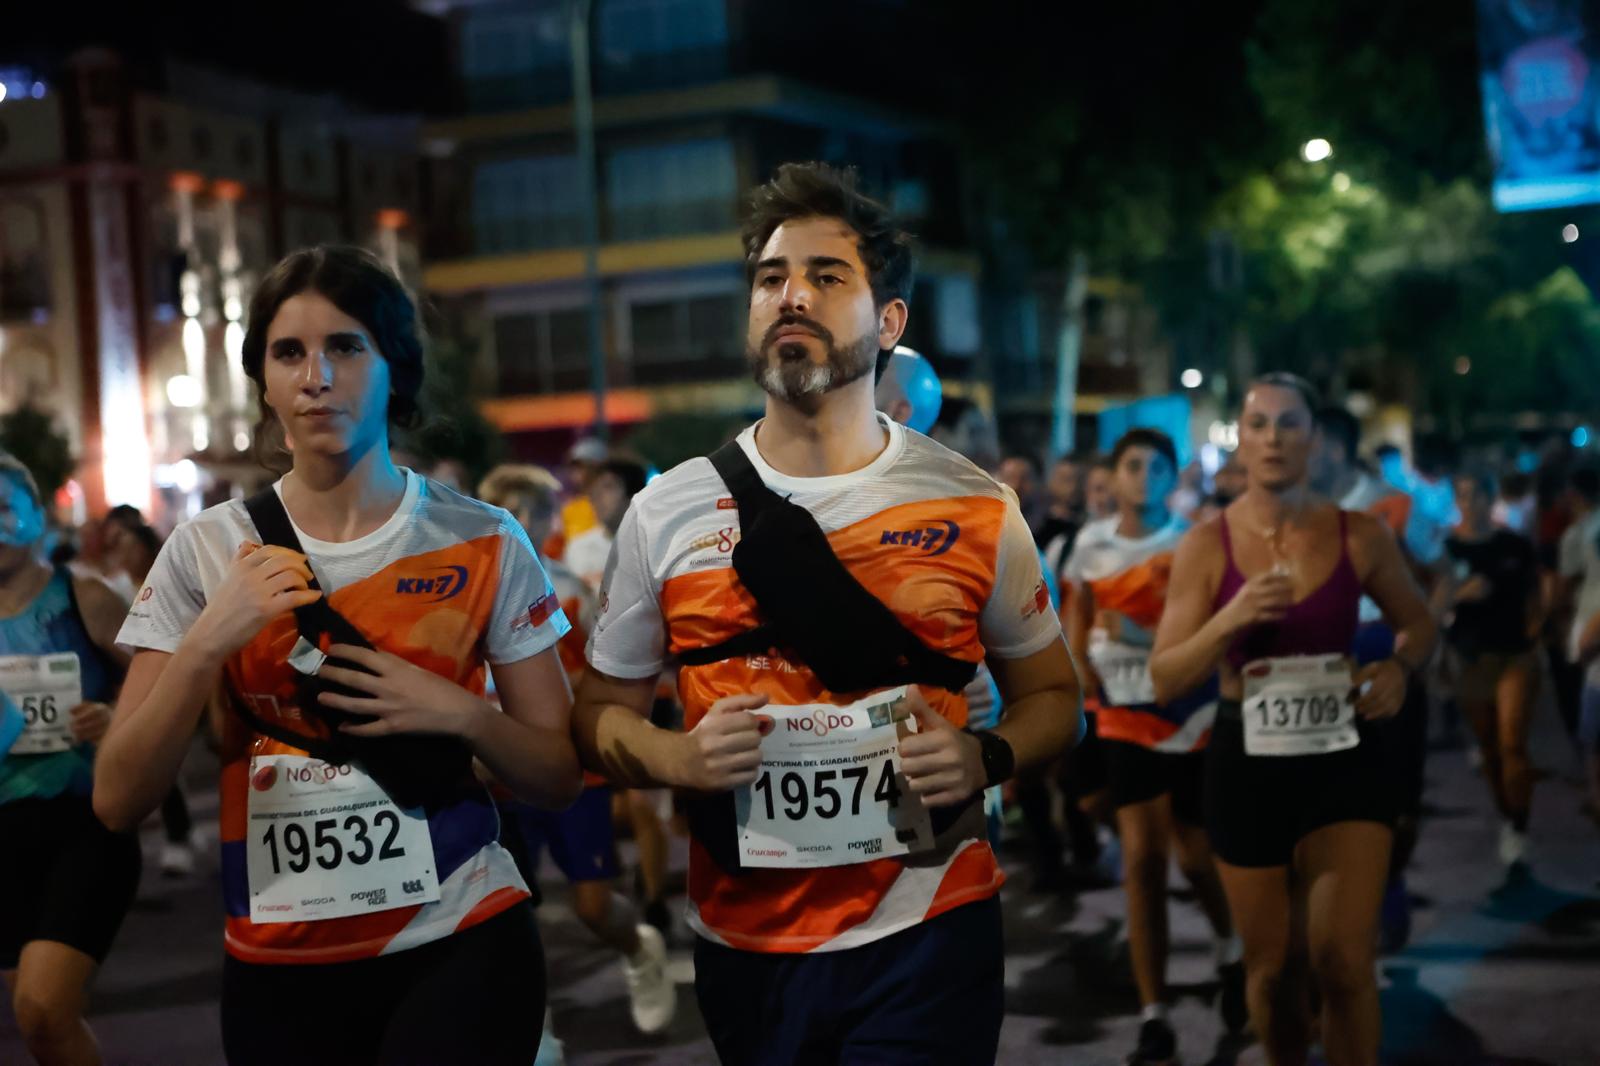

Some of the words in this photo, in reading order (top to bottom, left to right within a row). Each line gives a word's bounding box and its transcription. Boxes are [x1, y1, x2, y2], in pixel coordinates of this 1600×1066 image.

[1257, 694, 1340, 726] 13709
[804, 760, 818, 768] DEL
[820, 752, 878, 767] GUADALQUIVIR
[754, 759, 902, 821] 19574
[262, 810, 405, 874] 19532
[848, 838, 882, 850] POWER
[351, 888, 386, 901] POWER
